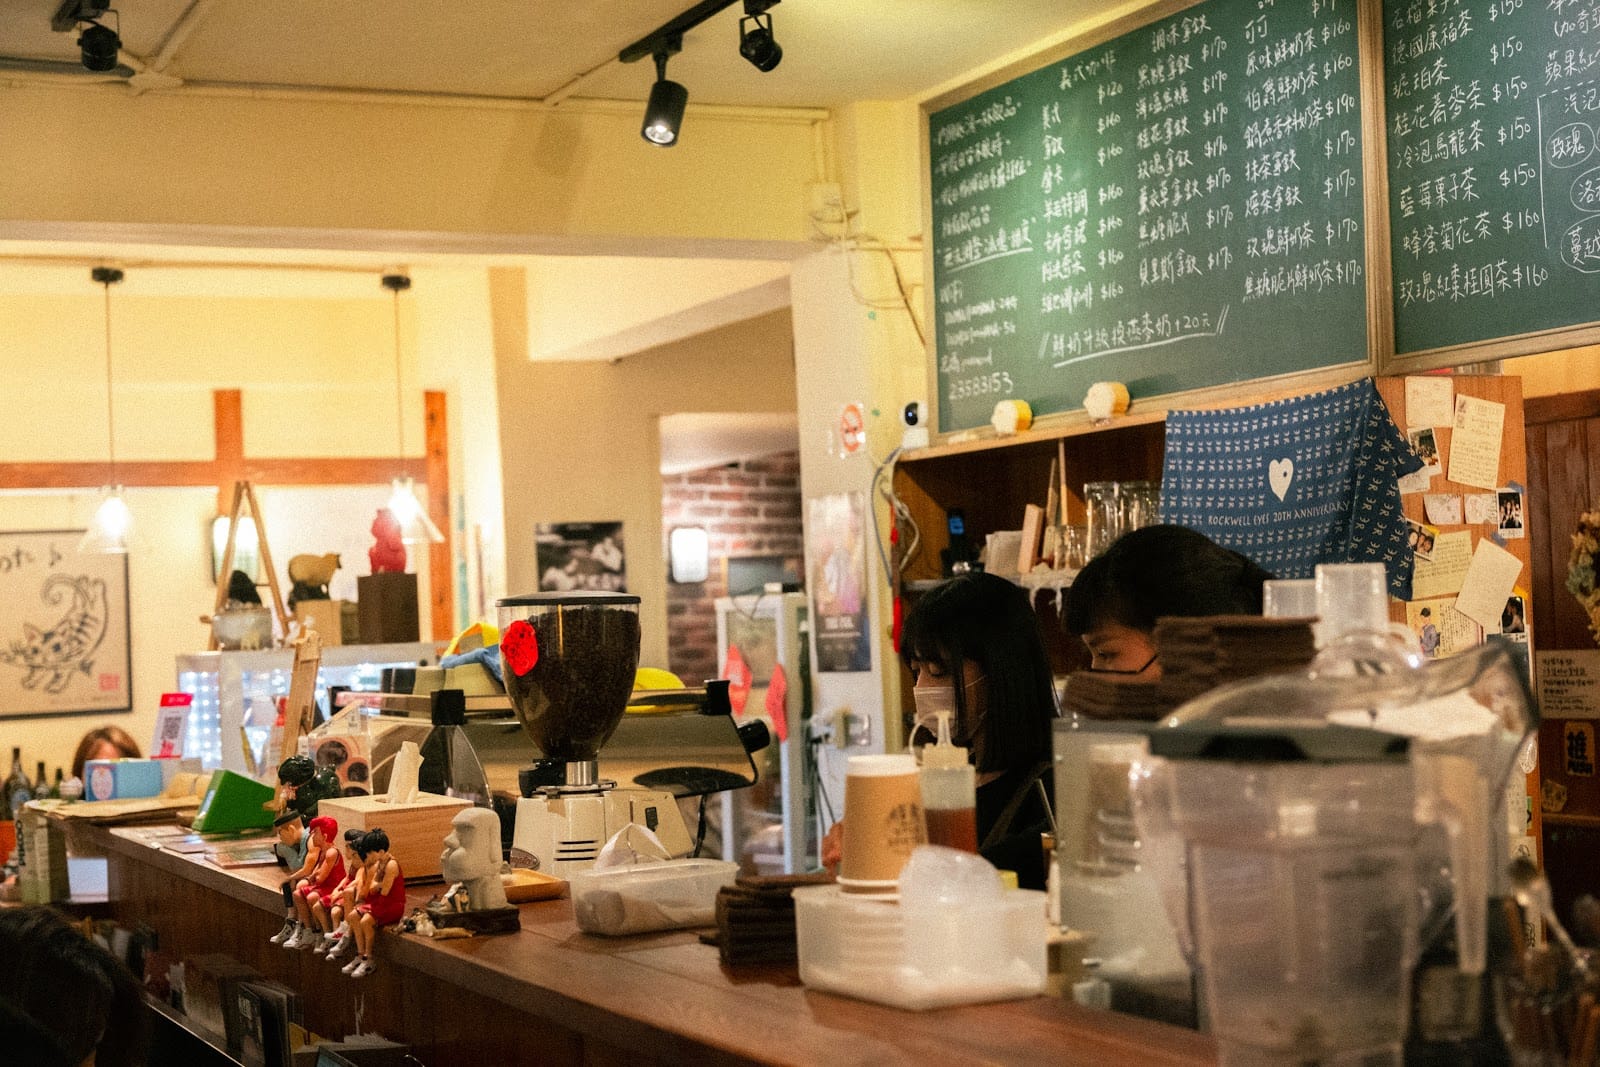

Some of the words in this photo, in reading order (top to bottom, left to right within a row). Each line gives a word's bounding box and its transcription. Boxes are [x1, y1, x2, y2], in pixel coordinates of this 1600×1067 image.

[1243, 14, 1268, 44] 可可
[1392, 9, 1474, 65] 德國康福茶
[1201, 35, 1228, 63] $170
[1245, 28, 1318, 76] 原味鮮奶茶
[1321, 18, 1351, 46] $160
[1392, 57, 1451, 99] 琥珀茶
[1490, 36, 1523, 65] $150
[1097, 82, 1123, 105] $120
[1202, 70, 1228, 94] $170
[1245, 63, 1320, 112] 伯爵鮮奶茶
[1323, 55, 1353, 80] $160
[1203, 102, 1229, 127] $170
[1325, 93, 1355, 119] $190
[1393, 80, 1486, 137] 桂花蕎麥茶
[1492, 75, 1528, 103] $150
[1097, 114, 1121, 135] $160
[1097, 143, 1123, 168] $160
[1204, 135, 1229, 159] $170
[1396, 119, 1485, 169] 冷泡烏龍茶
[1497, 117, 1532, 146] $150
[1551, 126, 1586, 159] 玫瑰
[1245, 150, 1301, 183] 抹茶拿鐵
[1324, 130, 1356, 160] $170
[1206, 167, 1232, 194] $170
[1324, 169, 1356, 199] $170
[1499, 163, 1536, 188] $150
[1098, 183, 1123, 206] $160
[1097, 217, 1123, 238] $160
[1206, 204, 1234, 230] $170
[1325, 218, 1358, 246] $170
[1403, 210, 1492, 260] 蜂蜜菊花茶
[1502, 208, 1540, 235] $160
[1098, 249, 1124, 270] $160
[1207, 246, 1233, 271] $170
[1336, 259, 1362, 286] $170
[1400, 258, 1512, 308] 玫瑰紅棗桂圓茶
[1512, 263, 1549, 289] $160
[1100, 281, 1124, 301] $160
[1208, 515, 1251, 526] ROCKWELL
[1253, 513, 1270, 526] EYES
[1273, 511, 1292, 522] 20TH
